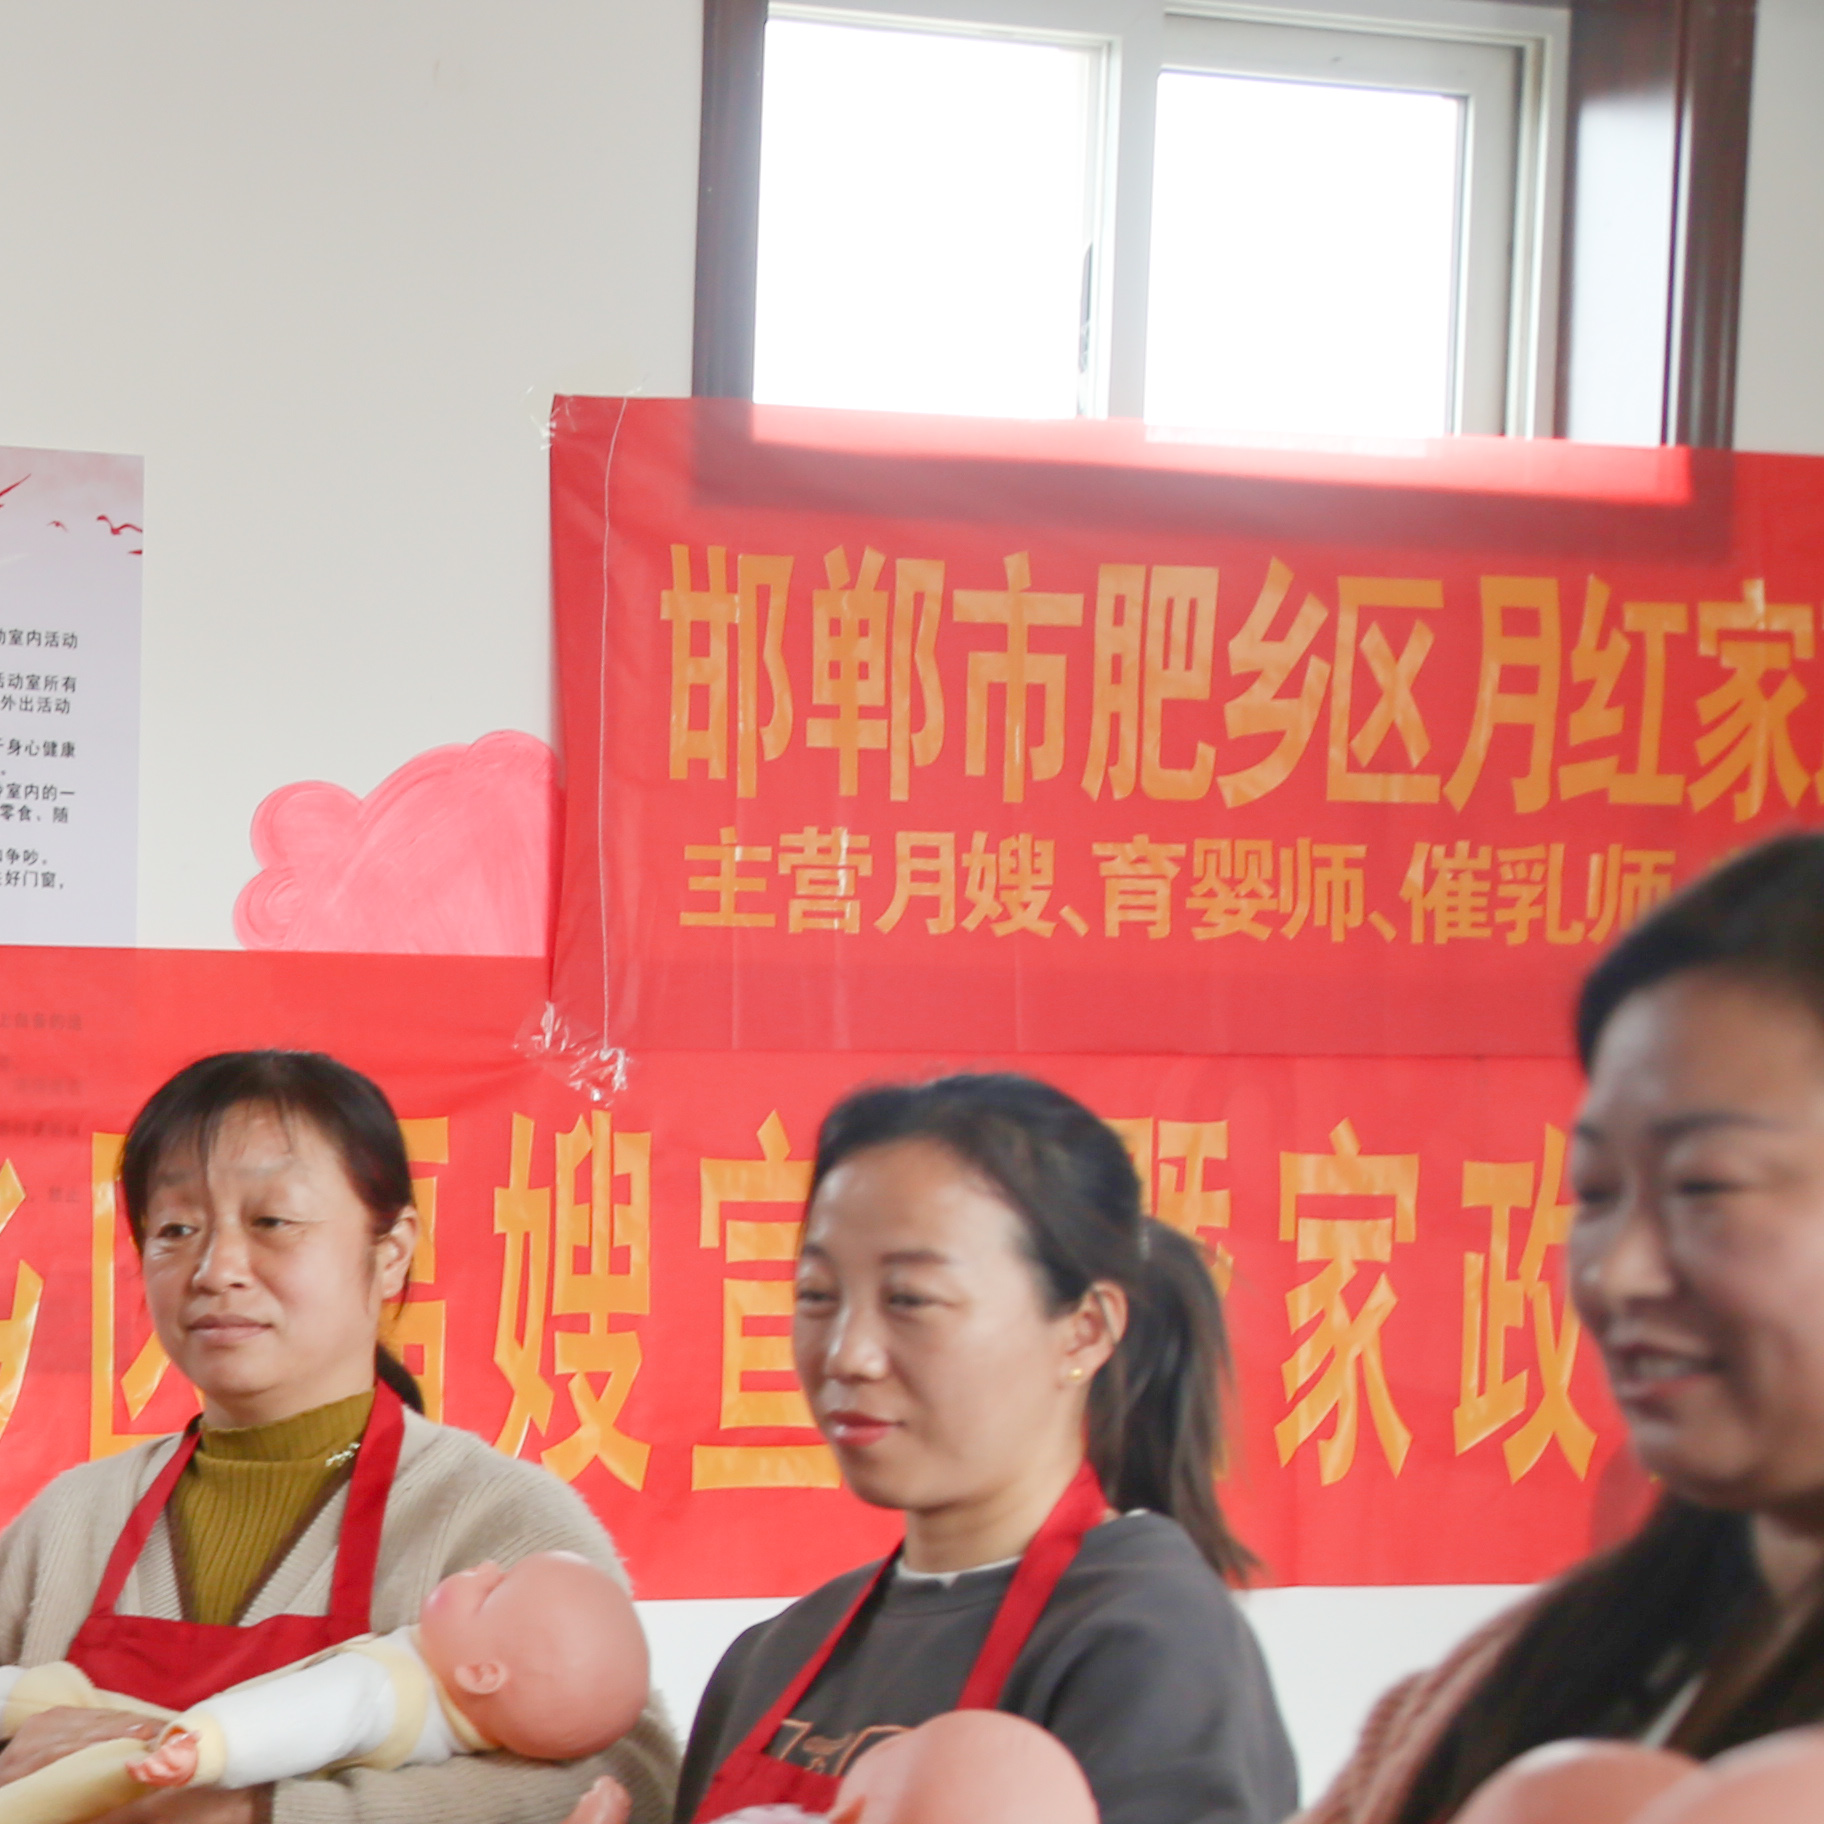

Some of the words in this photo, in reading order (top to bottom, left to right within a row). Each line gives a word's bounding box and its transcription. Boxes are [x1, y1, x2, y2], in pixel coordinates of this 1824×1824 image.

[659, 543, 1824, 824] 邯郸市肥乡区月红家
